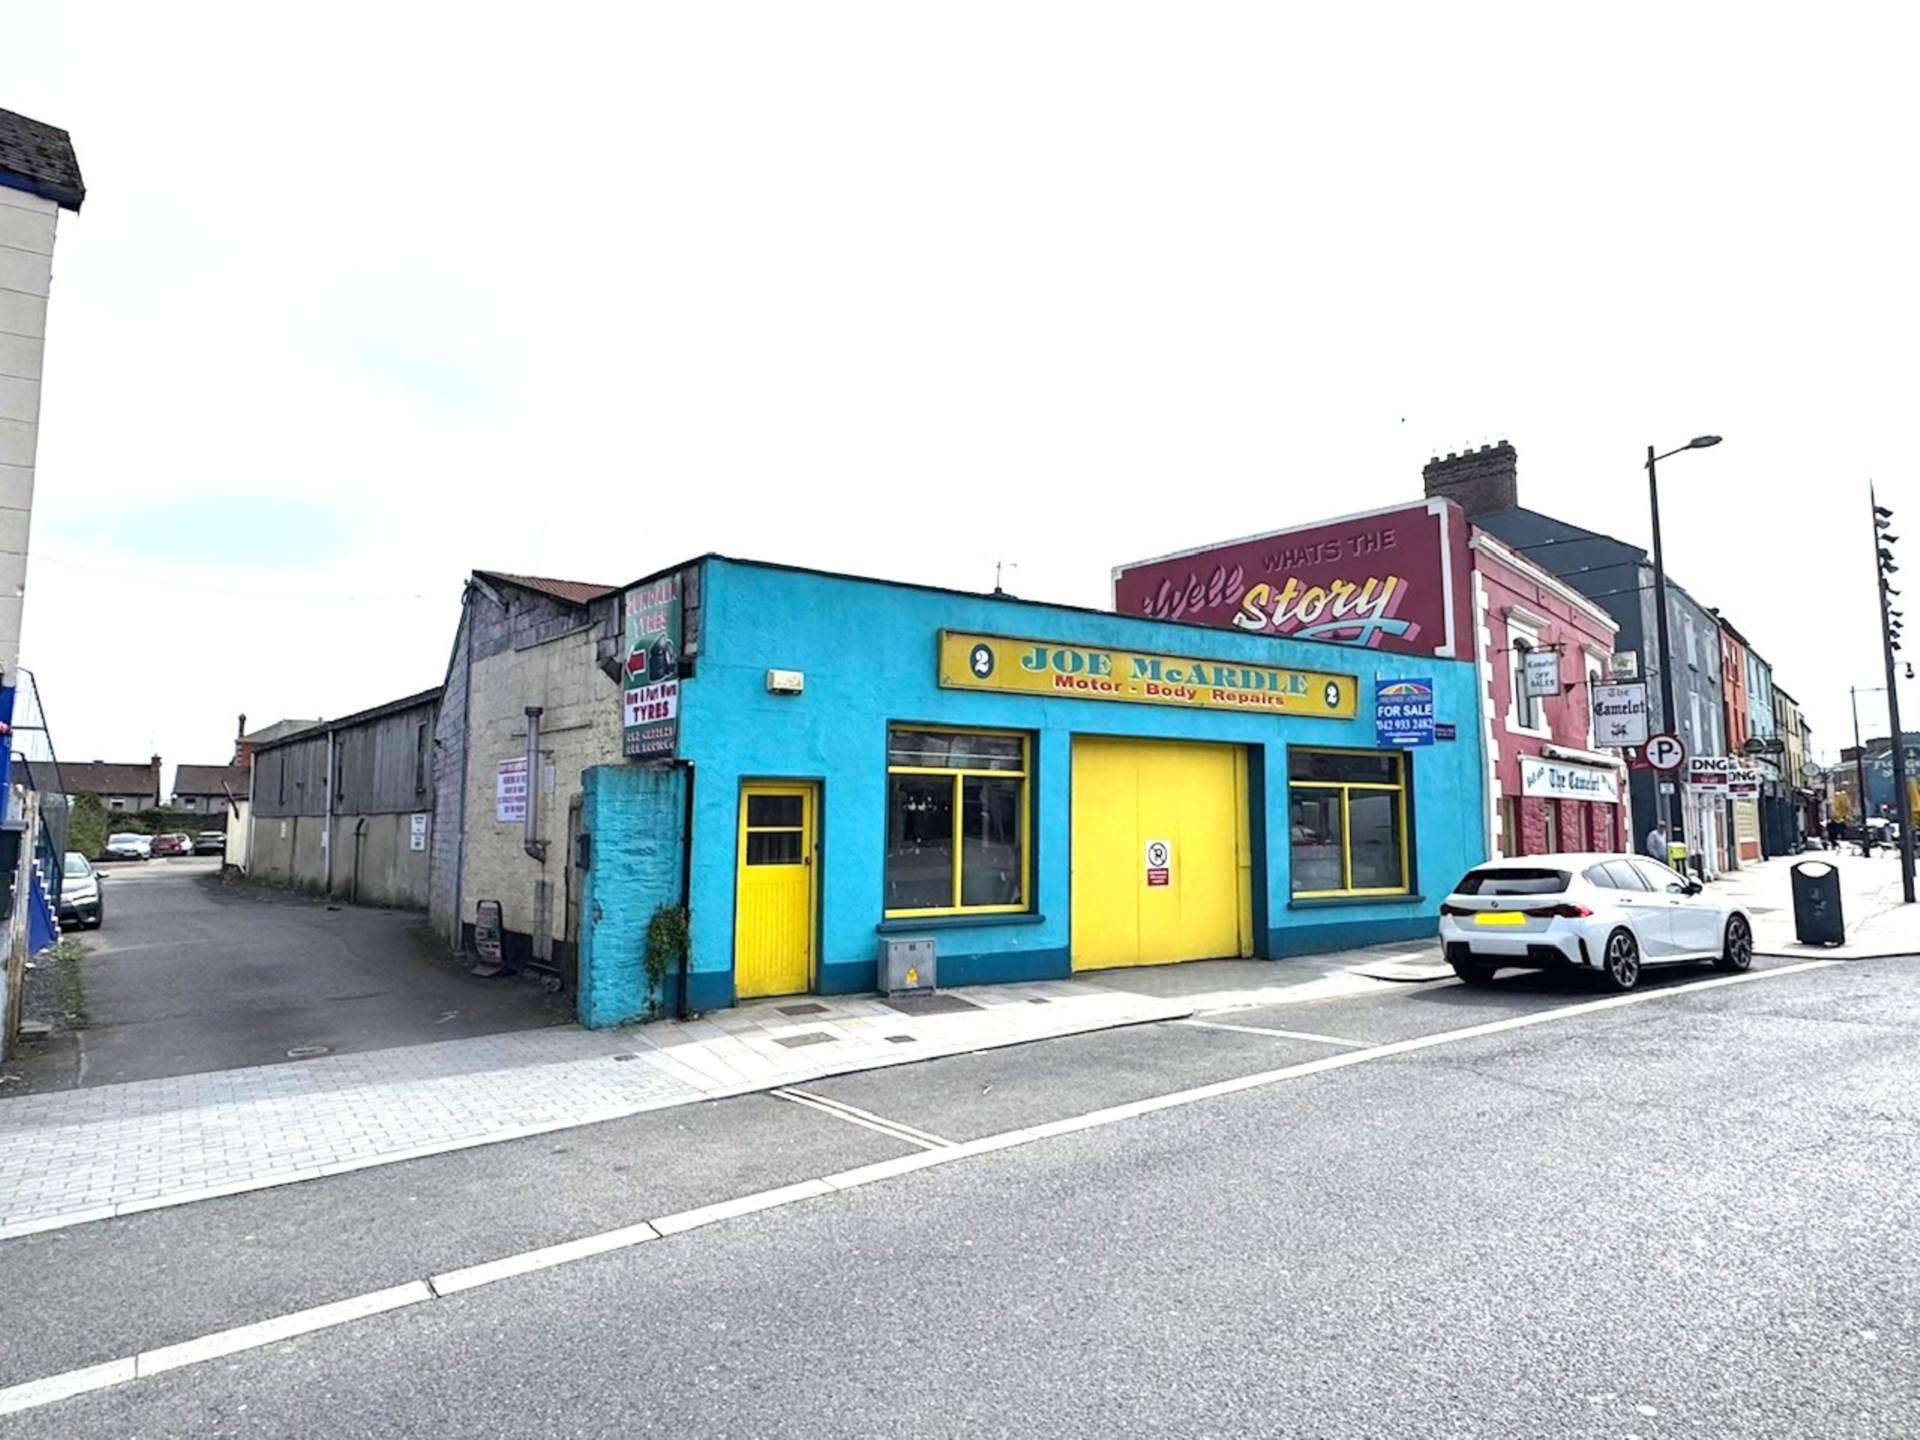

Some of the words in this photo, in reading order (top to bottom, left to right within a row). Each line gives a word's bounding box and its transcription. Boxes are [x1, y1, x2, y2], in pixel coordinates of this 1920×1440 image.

[1263, 538, 1343, 573] WHATS
[1347, 528, 1398, 558] THE
[1232, 575, 1412, 648] Story
[973, 649, 990, 674] 2
[1020, 647, 1113, 677] JOE
[1130, 656, 1309, 697] McARDLE
[1054, 674, 1123, 693] Motor
[1145, 682, 1198, 700] Body
[1211, 688, 1286, 707] Repairs
[1530, 679, 1555, 688] SALES
[1608, 687, 1630, 697] The
[1326, 686, 1339, 704] 2
[633, 700, 669, 722] TYRES
[1377, 705, 1401, 718] FOR
[1403, 703, 1433, 717] SALE
[1594, 699, 1646, 717] Camelot
[1656, 740, 1674, 764] P
[1692, 759, 1727, 771] DNG
[1548, 768, 1566, 788] The
